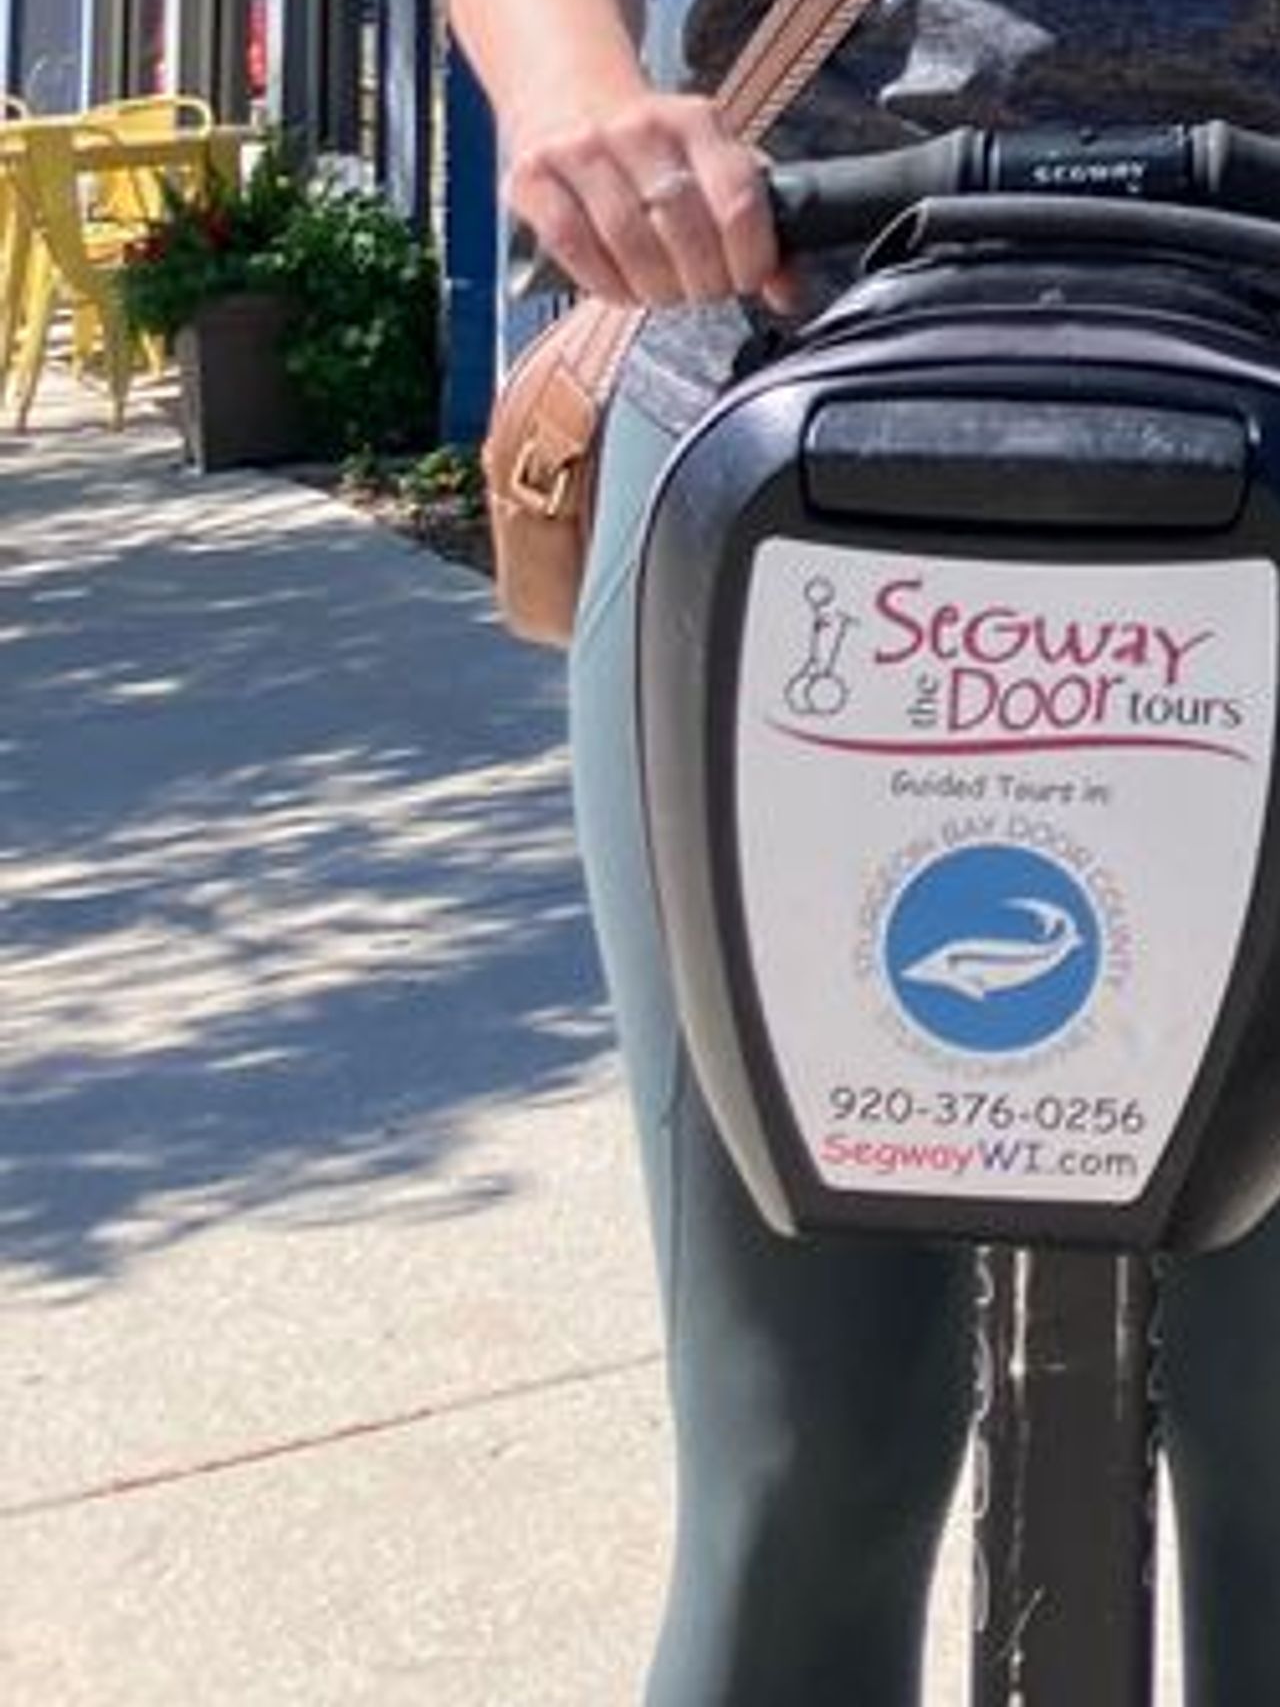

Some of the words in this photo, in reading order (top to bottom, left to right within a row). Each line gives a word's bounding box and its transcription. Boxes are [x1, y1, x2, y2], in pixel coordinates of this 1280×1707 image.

[907, 675, 941, 729] the
[1129, 689, 1243, 728] tours
[890, 768, 987, 800] Guided
[829, 1087, 1146, 1136] 920-376-0256
[818, 1133, 1140, 1179] SegwayWI.com
